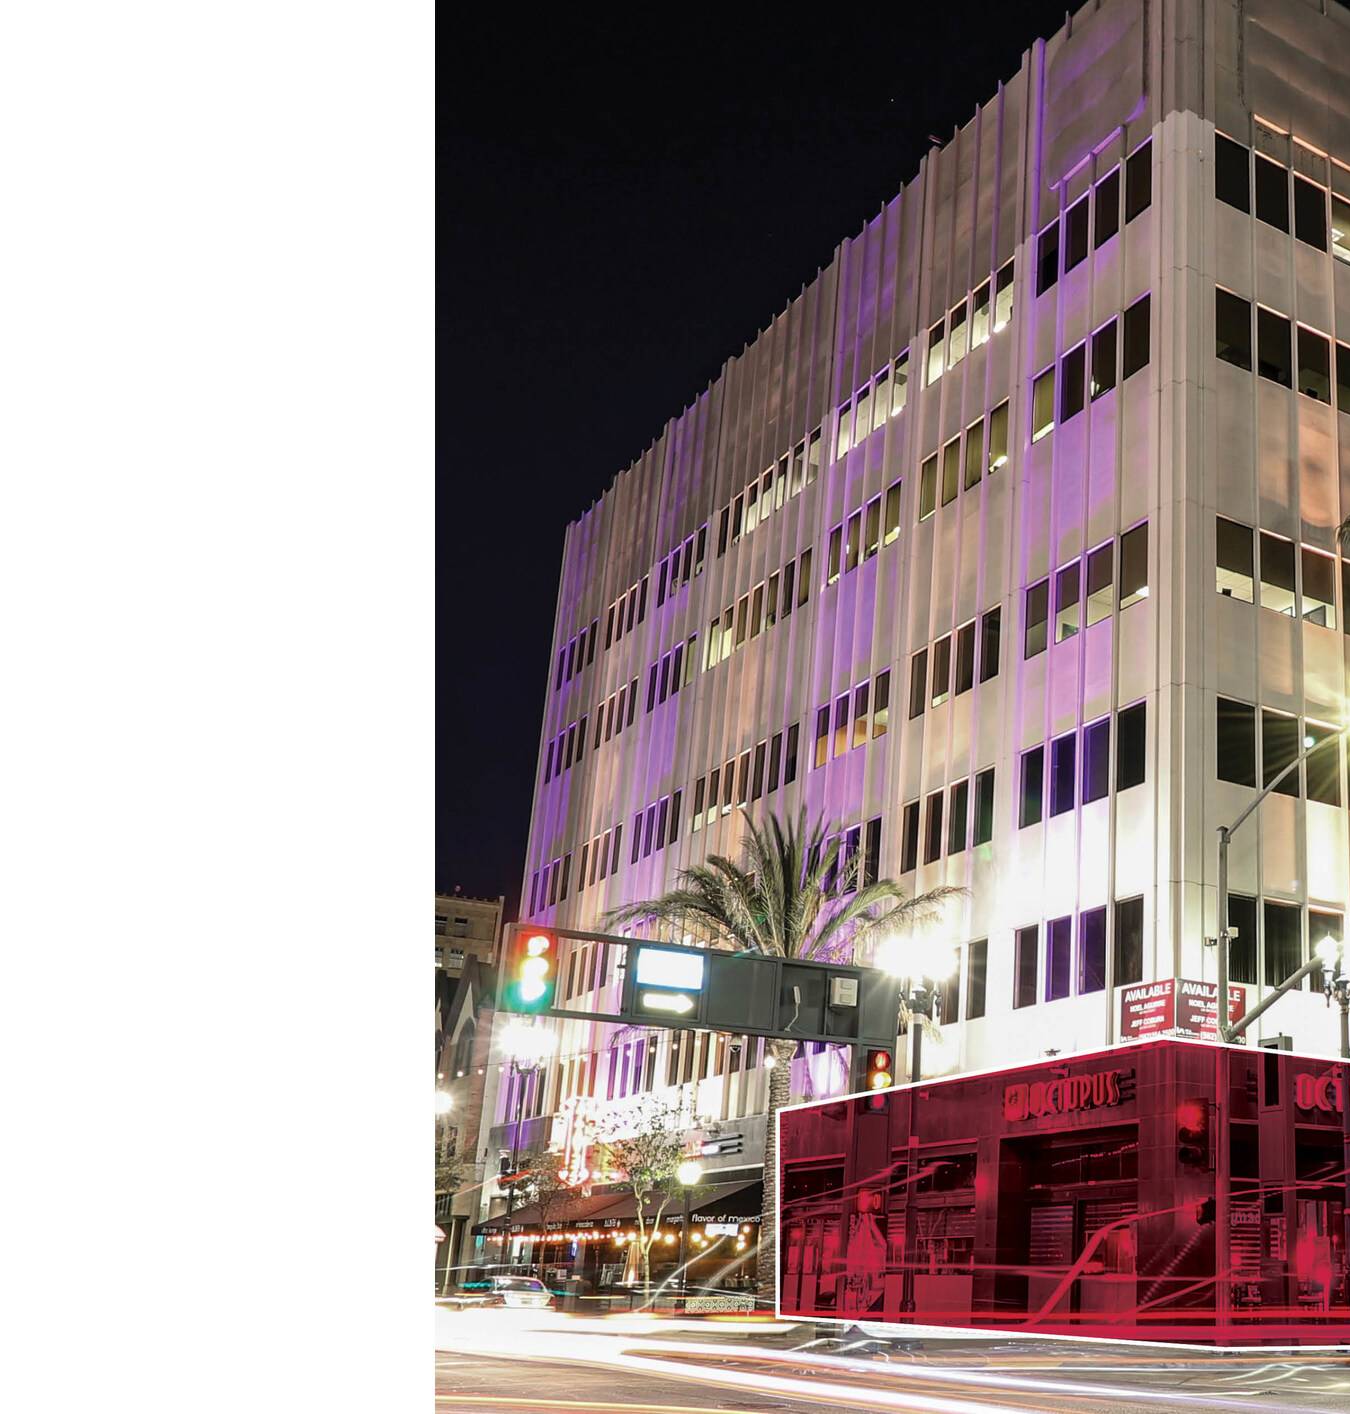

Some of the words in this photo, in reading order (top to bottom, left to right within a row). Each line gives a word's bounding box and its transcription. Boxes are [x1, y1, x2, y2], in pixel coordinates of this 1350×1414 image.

[1125, 983, 1171, 1002] AVAILABLE
[1182, 982, 1241, 1002] AVAILALE
[1189, 999, 1205, 1008] NOEL
[1190, 1014, 1205, 1023] JEFF
[692, 1213, 715, 1222] flavor
[717, 1214, 727, 1222] of
